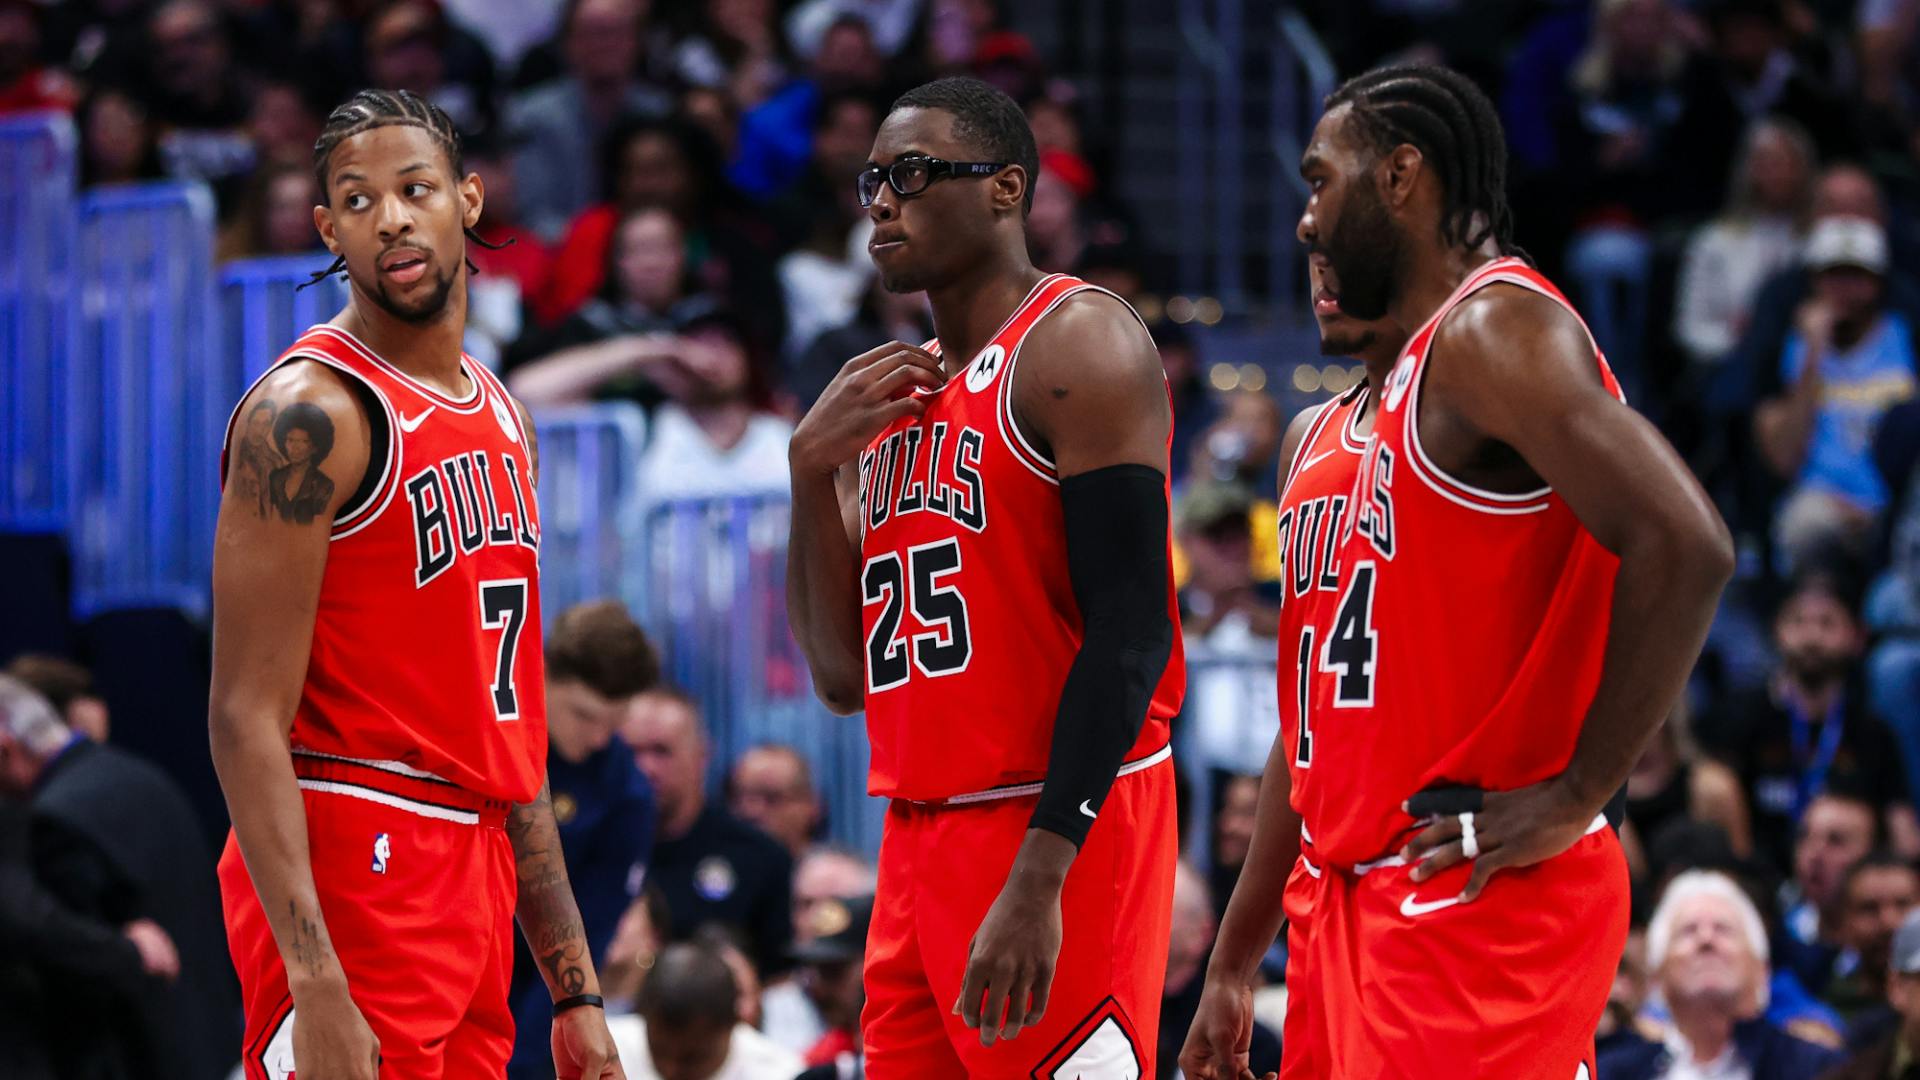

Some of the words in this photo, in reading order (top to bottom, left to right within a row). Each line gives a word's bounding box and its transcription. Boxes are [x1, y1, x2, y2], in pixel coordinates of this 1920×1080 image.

[404, 450, 541, 589] BULL
[478, 577, 528, 721] 7
[861, 536, 973, 694] 25
[1318, 560, 1379, 709] 4
